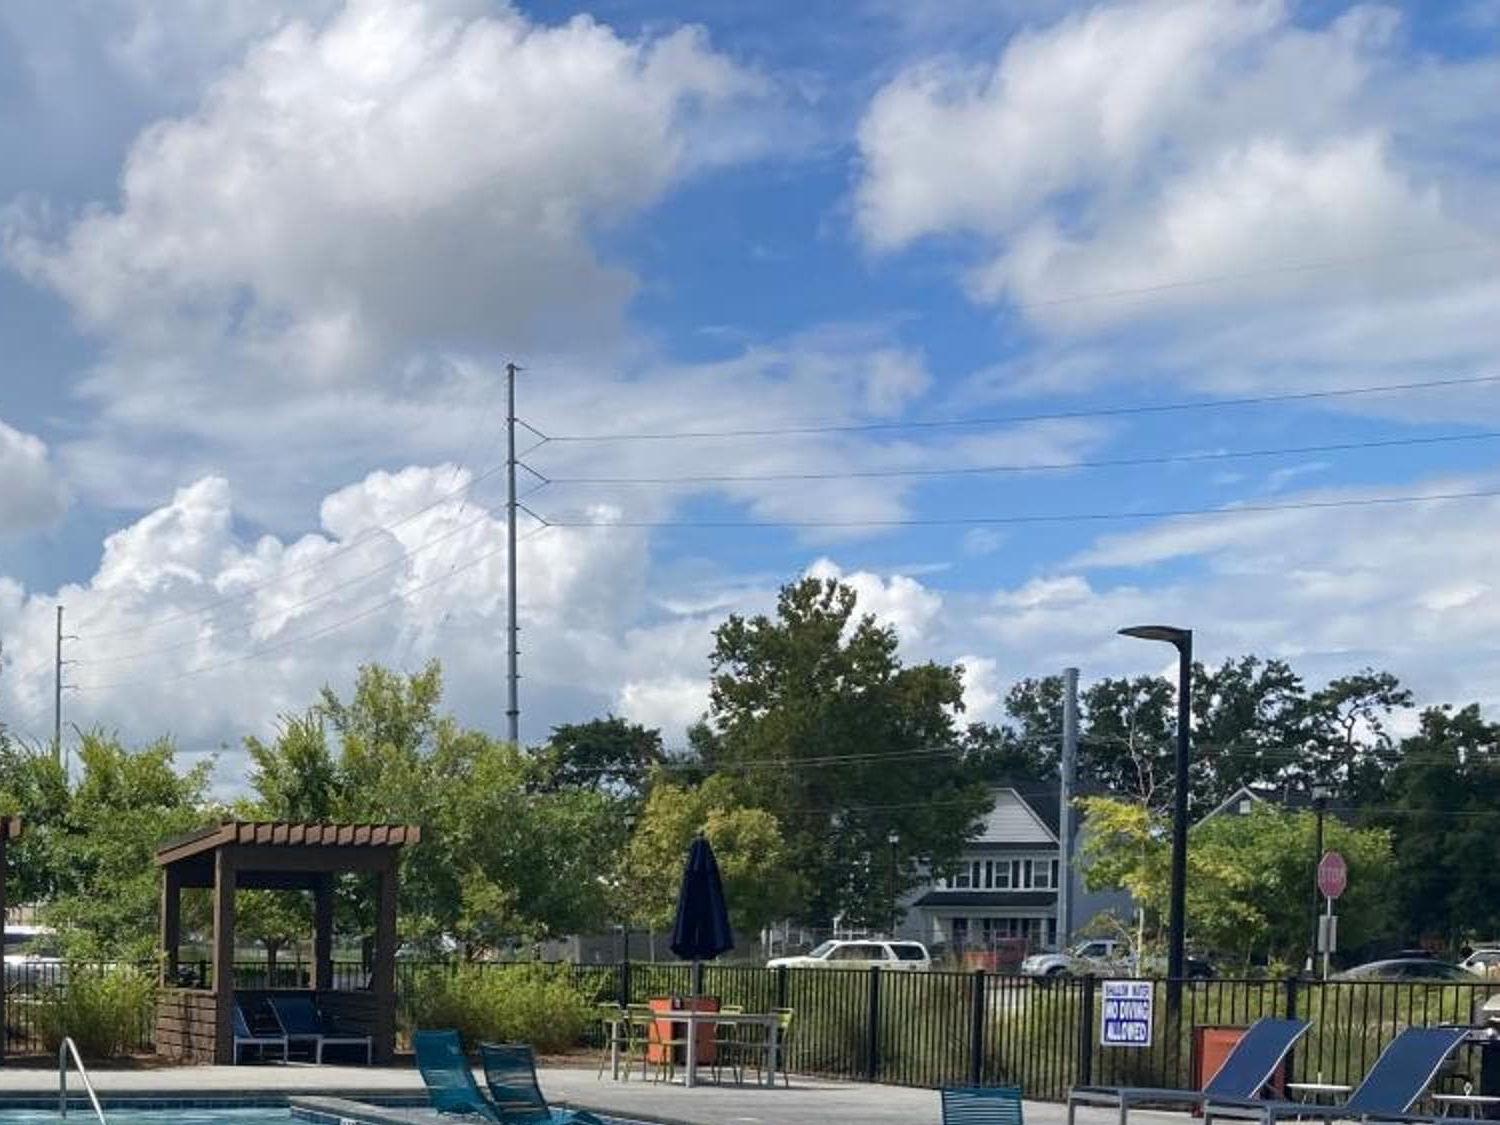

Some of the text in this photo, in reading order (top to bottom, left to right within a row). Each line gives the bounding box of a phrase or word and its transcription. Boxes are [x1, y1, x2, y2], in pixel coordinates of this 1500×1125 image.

[1105, 1001, 1149, 1020] NO DIVING
[1106, 1021, 1147, 1040] ALLOWED
